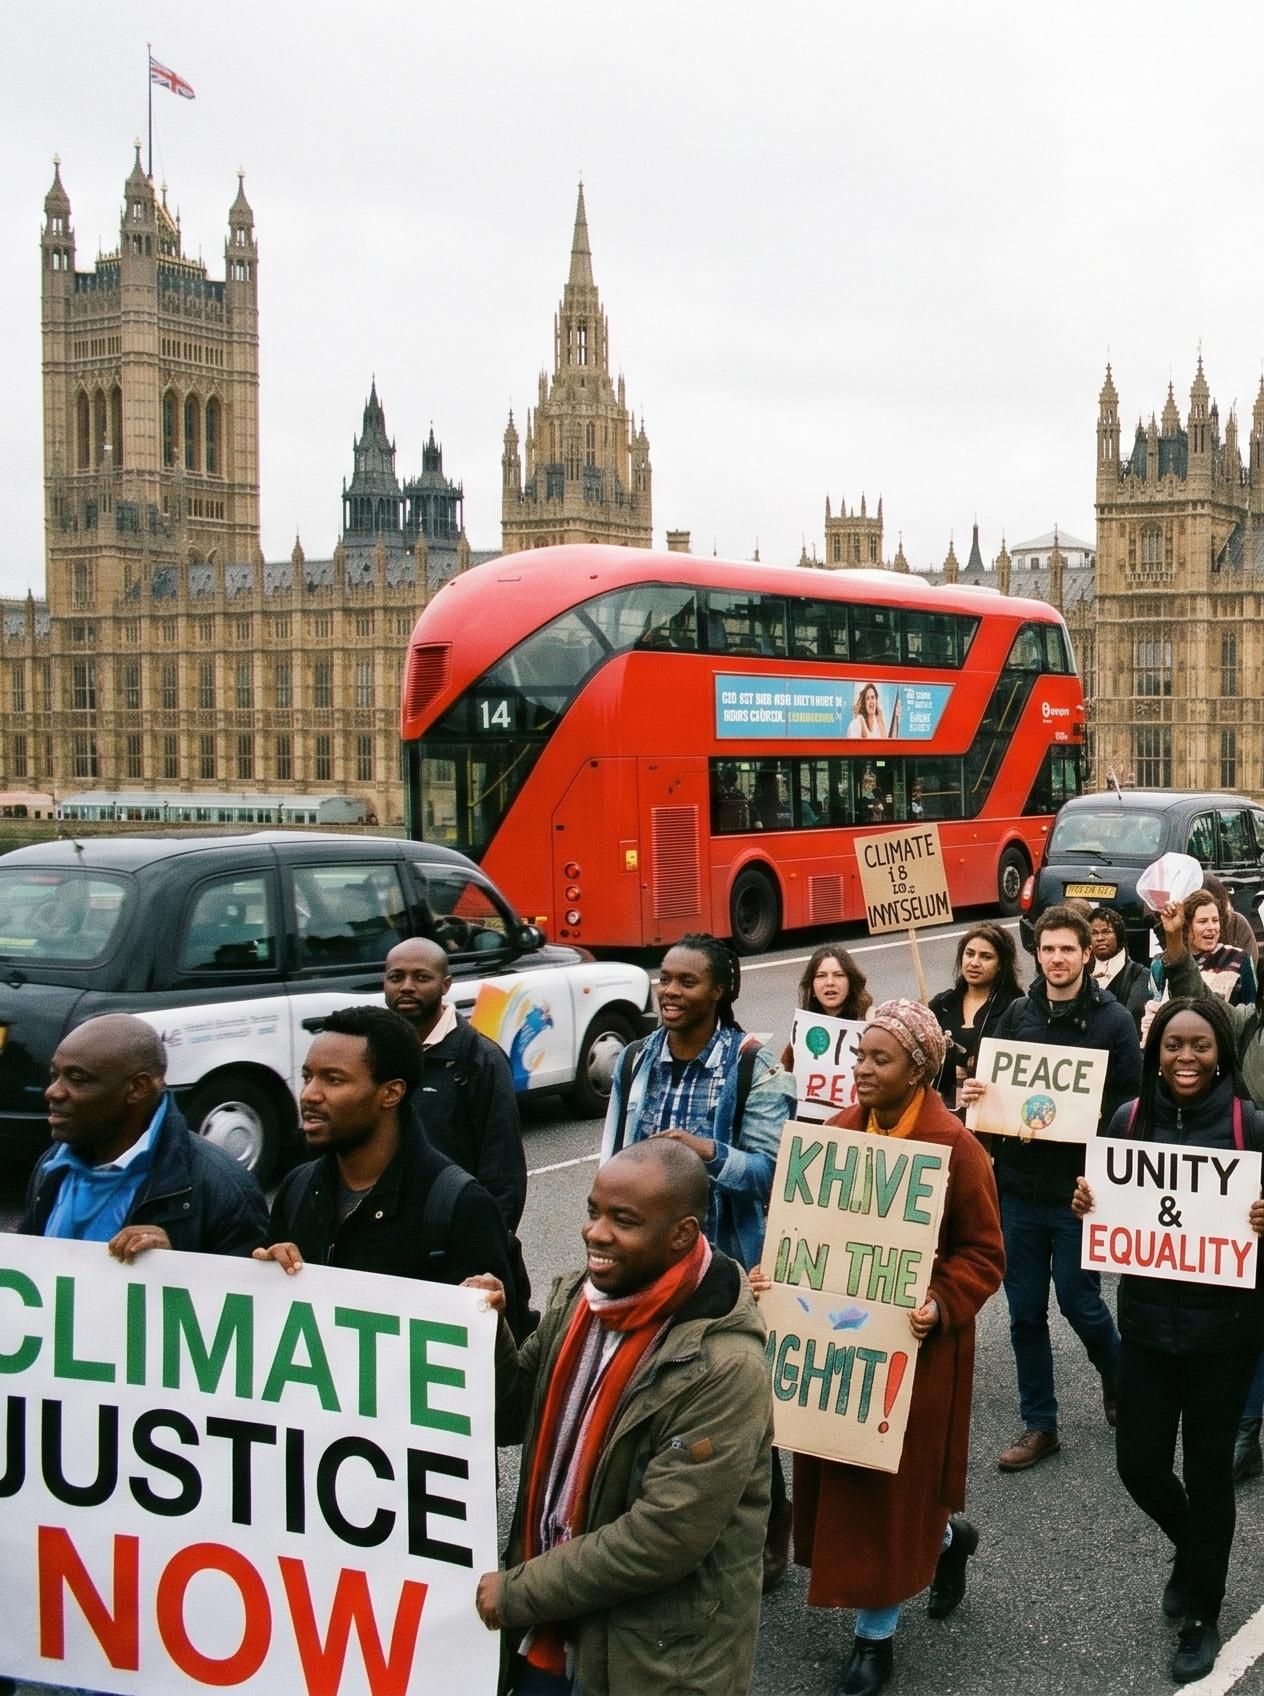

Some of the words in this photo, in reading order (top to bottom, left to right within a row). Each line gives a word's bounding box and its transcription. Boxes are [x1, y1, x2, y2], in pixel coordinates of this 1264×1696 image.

[480, 700, 511, 728] 14
[864, 833, 935, 868] CLIMATE
[991, 1052, 1094, 1094] PEACE
[1107, 1147, 1240, 1196] UNITY
[1158, 1195, 1183, 1228] &
[774, 1236, 829, 1290] IN
[845, 1241, 922, 1308] THE
[1088, 1224, 1253, 1278] EQUALITY
[0, 1268, 472, 1437] CLIMATE
[0, 1396, 473, 1568] JUSTICE
[37, 1525, 429, 1696] NOW
